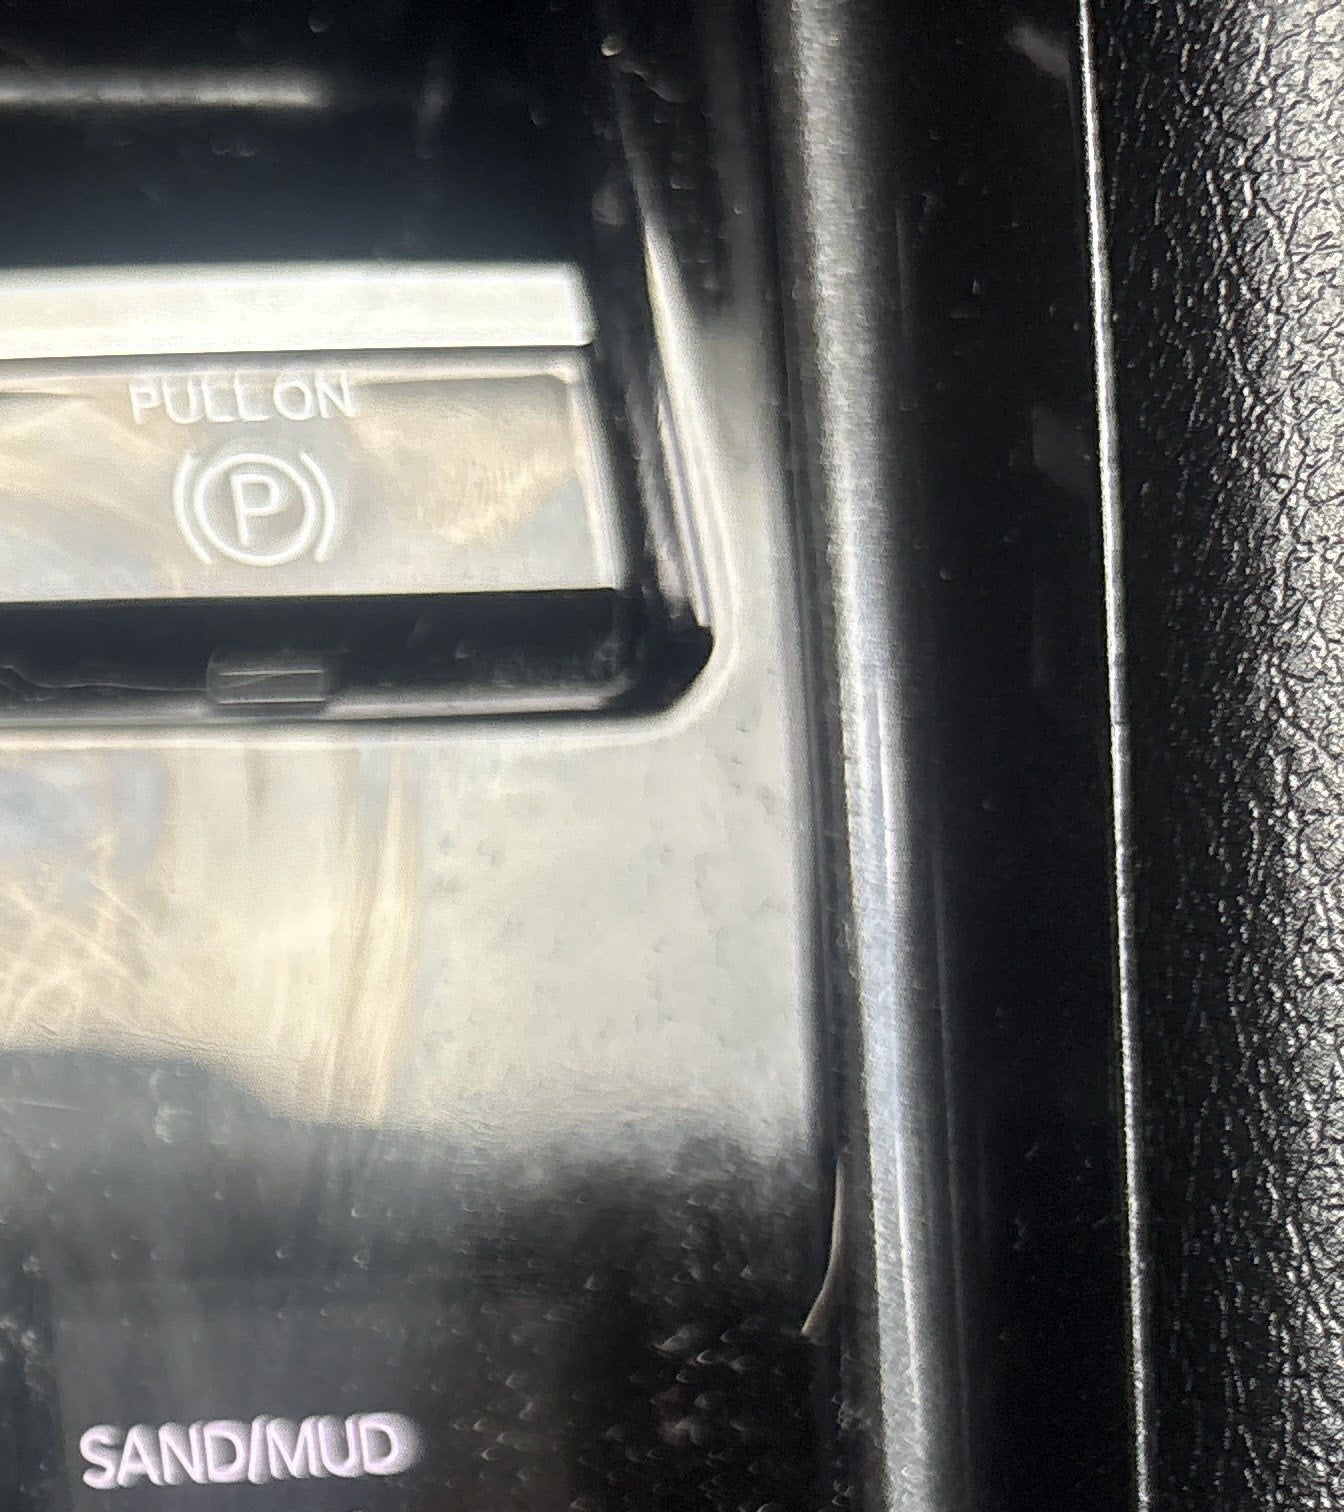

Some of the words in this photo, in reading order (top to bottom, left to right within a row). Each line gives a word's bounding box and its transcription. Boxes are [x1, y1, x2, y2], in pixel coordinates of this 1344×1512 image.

[129, 374, 271, 425] PULL
[273, 371, 362, 421] ON
[79, 1410, 420, 1490] SAND/MUD
